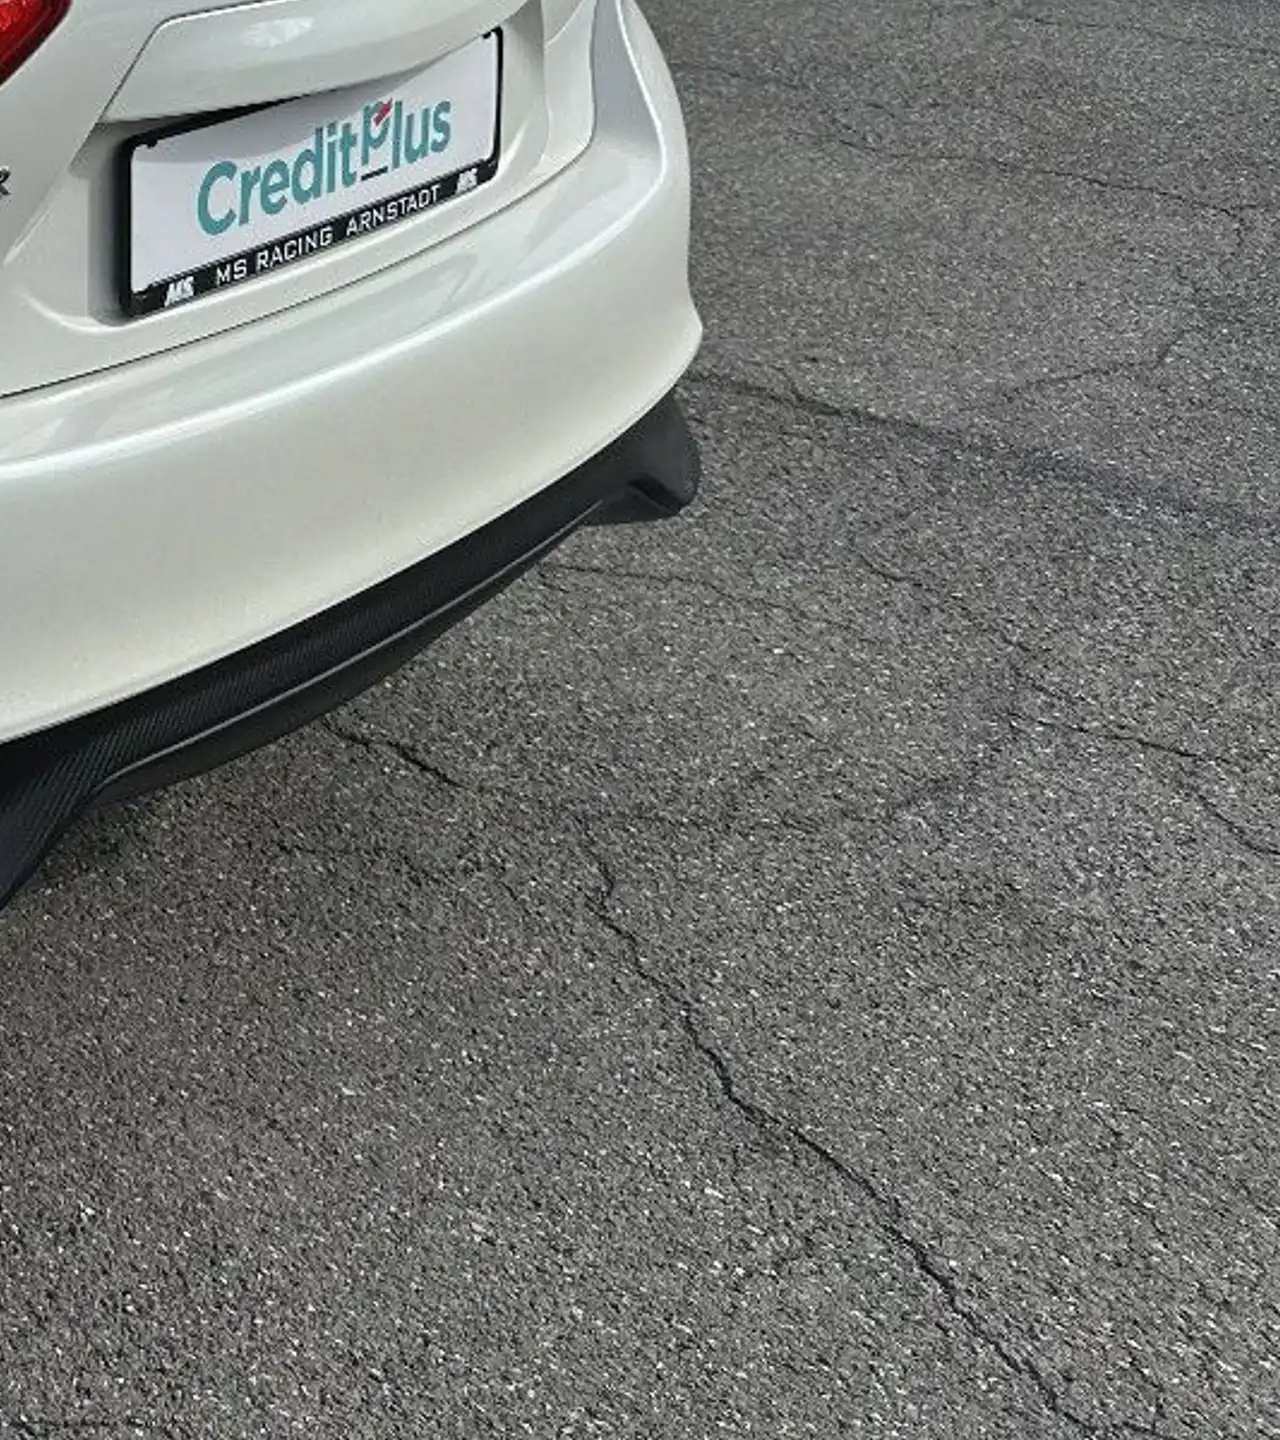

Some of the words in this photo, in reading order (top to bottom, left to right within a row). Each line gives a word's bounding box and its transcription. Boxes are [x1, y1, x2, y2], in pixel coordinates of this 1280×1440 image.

[197, 98, 452, 236] CreditPlus
[216, 259, 247, 287] MS
[256, 227, 334, 271] RACING
[346, 185, 440, 237] ARNSTADT
